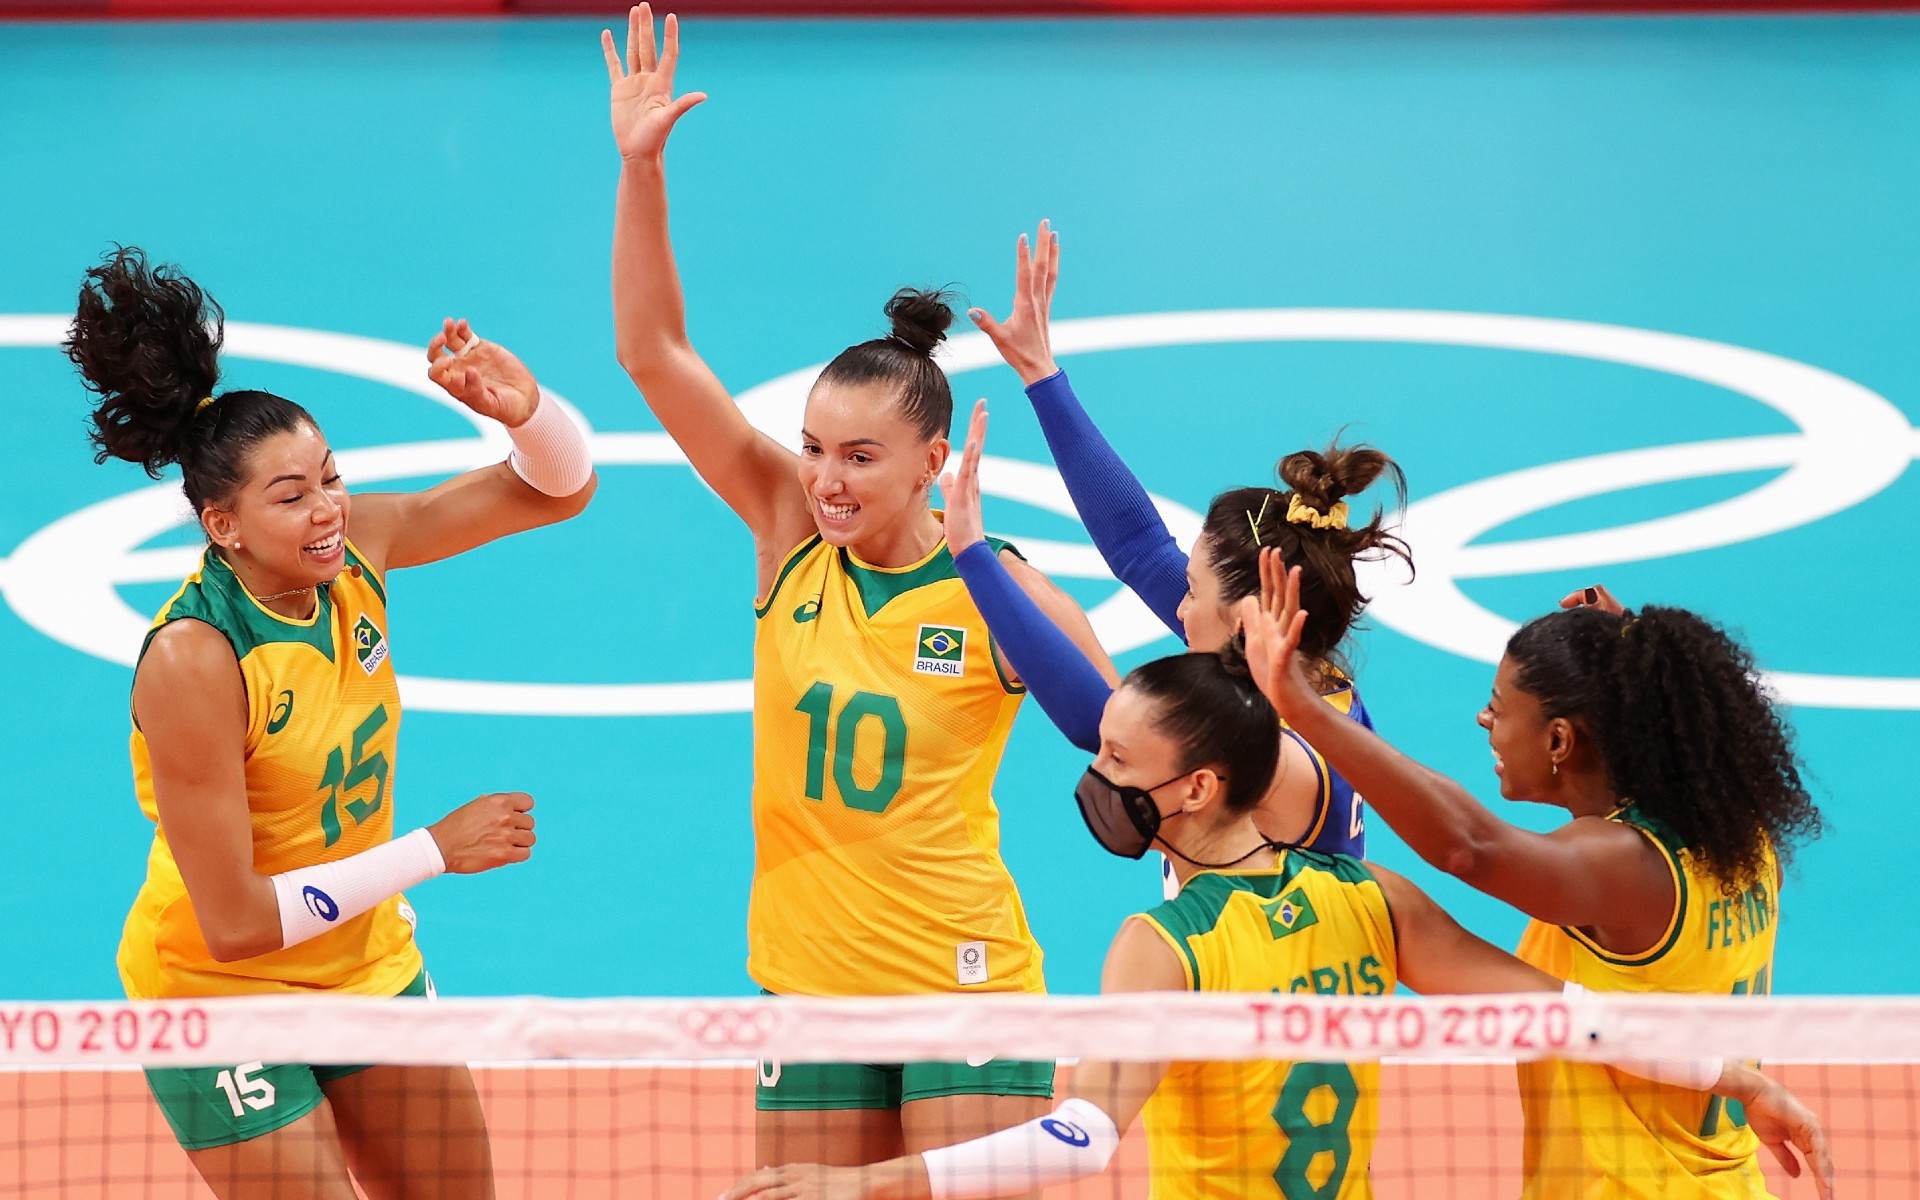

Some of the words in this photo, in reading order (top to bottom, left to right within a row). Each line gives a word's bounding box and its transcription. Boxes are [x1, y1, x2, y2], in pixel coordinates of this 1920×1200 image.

[364, 644, 387, 673] BRASIL
[916, 660, 960, 675] BRASIL
[795, 681, 908, 814] 10
[317, 702, 389, 848] 15
[0, 1009, 60, 1052] YO
[78, 1007, 208, 1051] 2020
[1249, 1003, 1426, 1048] TOKYO
[1442, 1002, 1572, 1048] 2020
[215, 1060, 275, 1117] 15
[1271, 1062, 1360, 1200] 8
